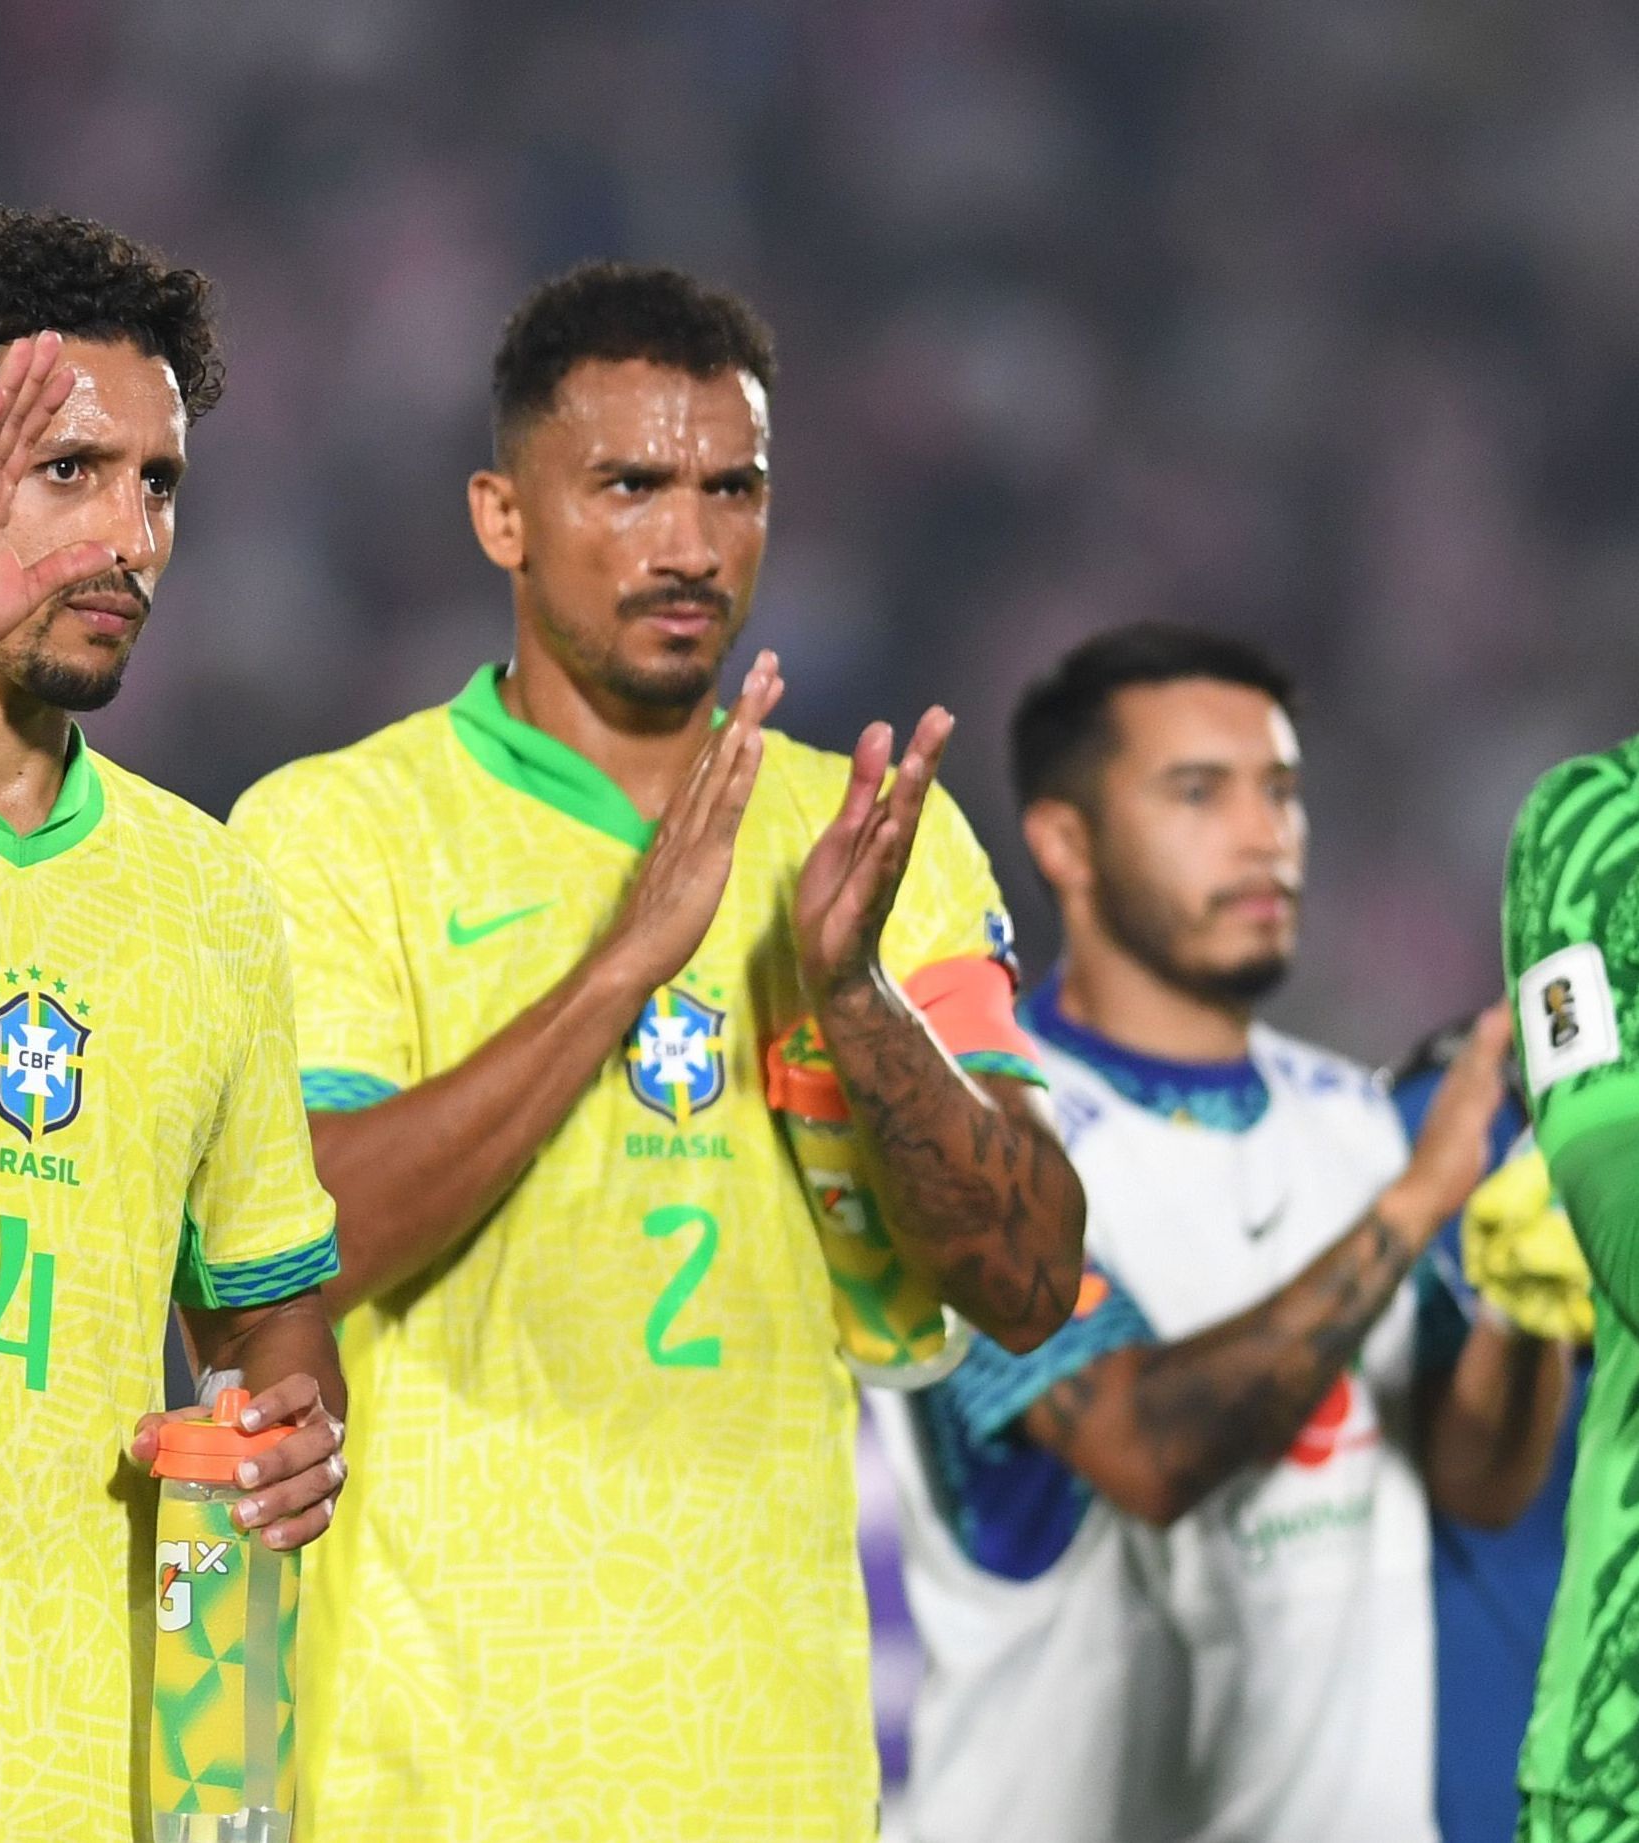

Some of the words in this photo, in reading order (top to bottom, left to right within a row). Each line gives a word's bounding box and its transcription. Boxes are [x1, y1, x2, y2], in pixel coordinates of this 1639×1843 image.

[18, 1049, 56, 1071] CBF
[625, 1133, 735, 1161] BRASIL
[641, 1203, 722, 1368] 2
